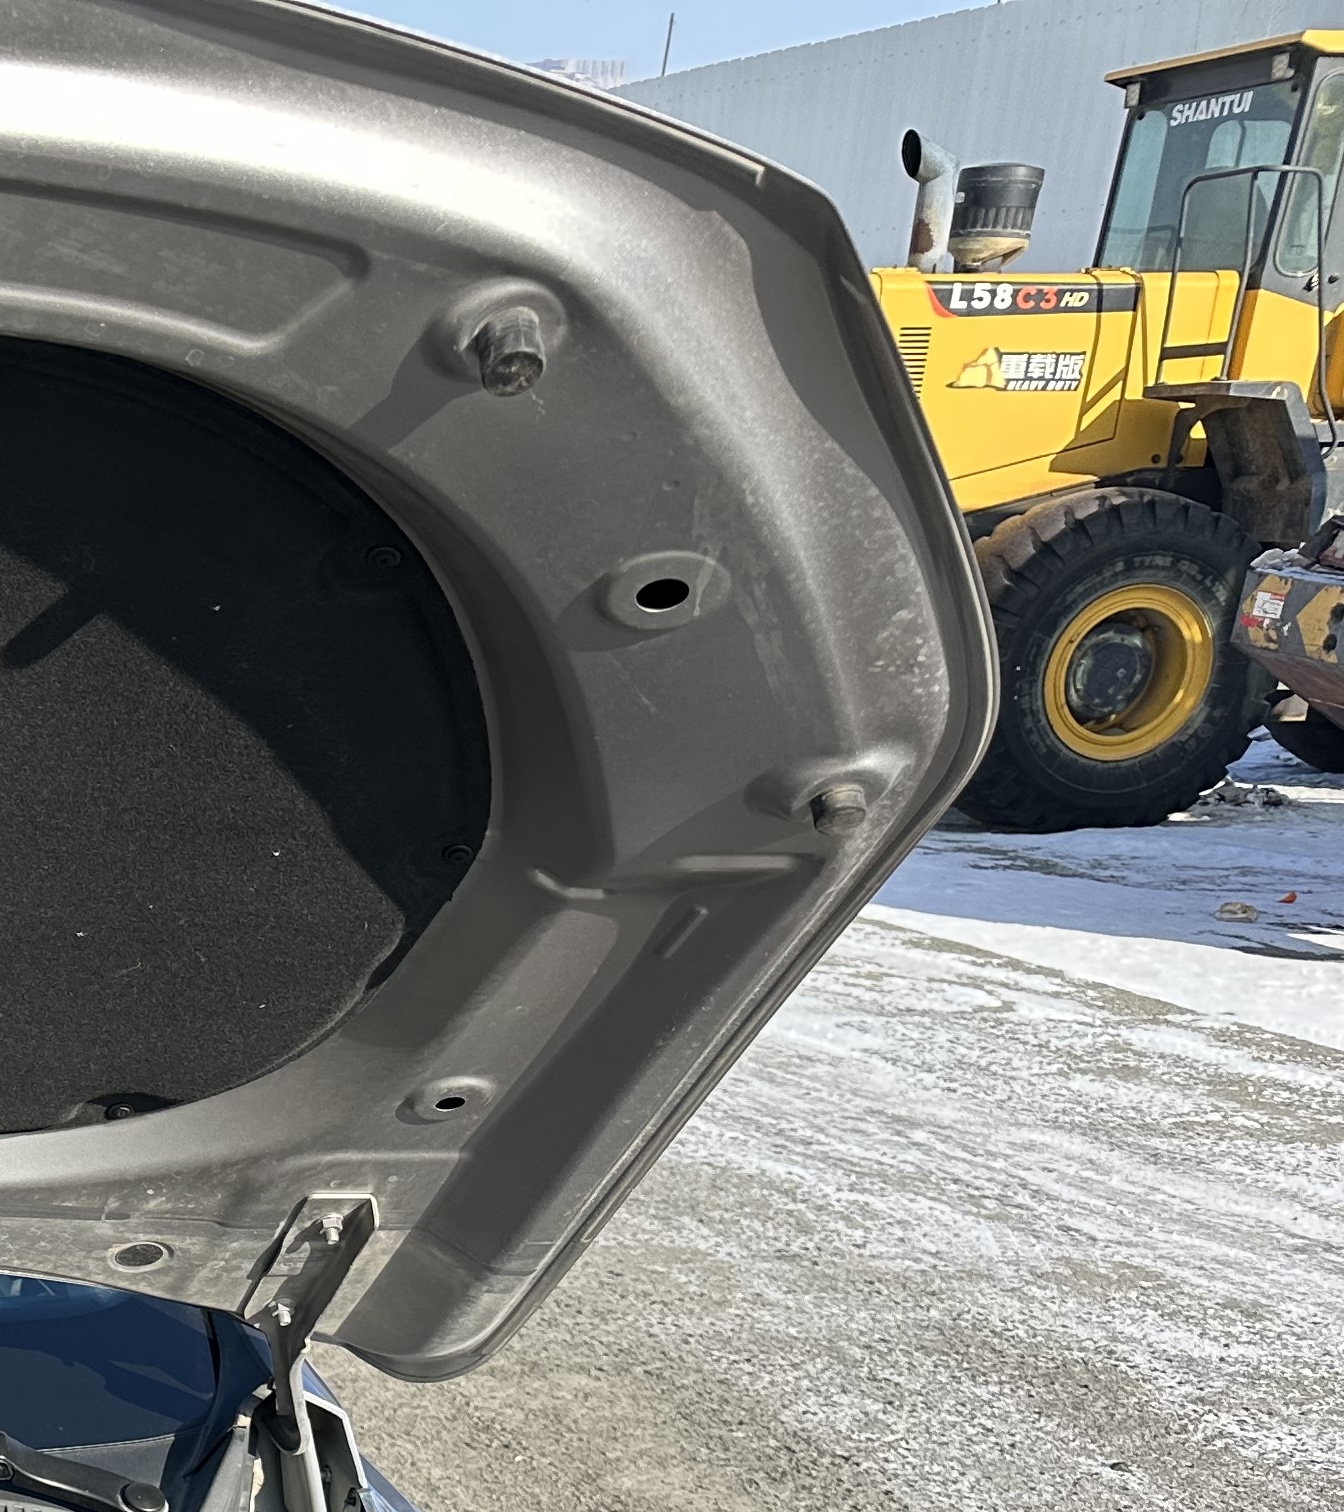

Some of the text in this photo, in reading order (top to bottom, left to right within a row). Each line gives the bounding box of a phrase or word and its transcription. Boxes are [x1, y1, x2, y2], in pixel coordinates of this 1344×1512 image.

[1169, 90, 1255, 127] SHANTUI
[1060, 291, 1090, 307] HD
[1001, 353, 1086, 380] 重载版
[1006, 380, 1079, 391] HEAVY DUTY
